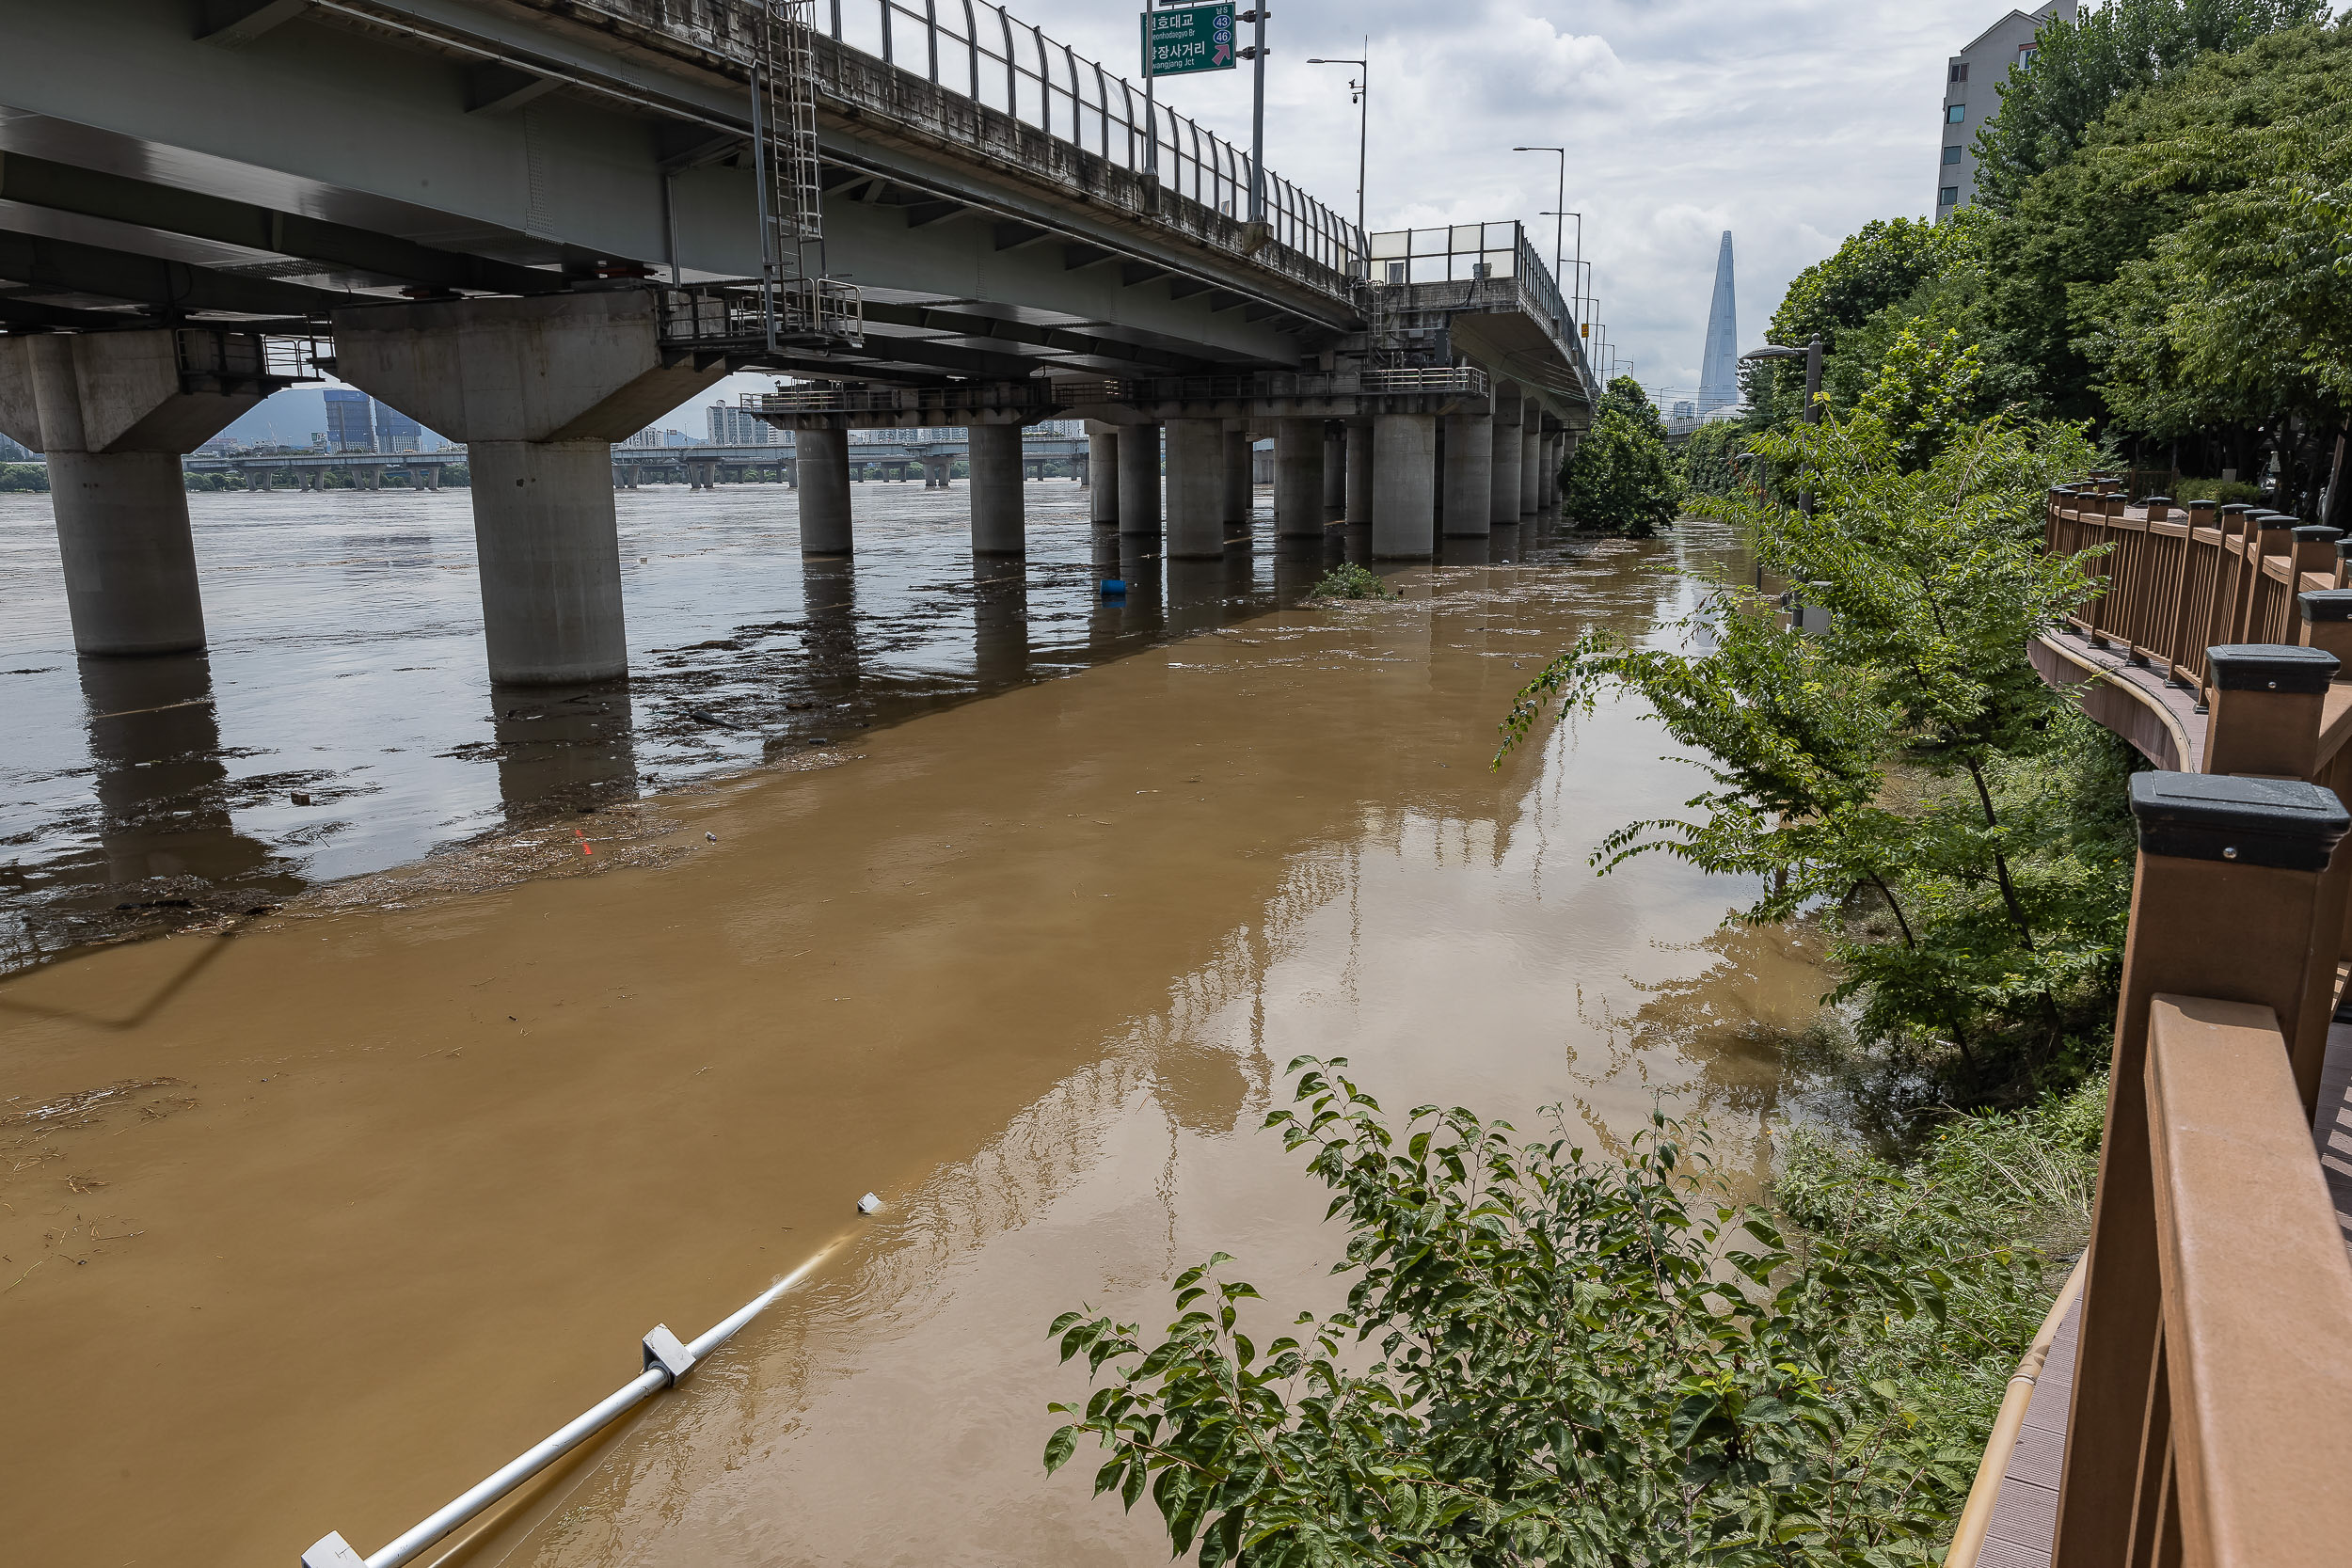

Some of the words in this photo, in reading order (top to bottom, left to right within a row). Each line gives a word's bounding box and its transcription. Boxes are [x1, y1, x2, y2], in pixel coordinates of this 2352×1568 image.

[1216, 17, 1228, 26] 43
[1152, 31, 1188, 40] eonhodaegyo
[1216, 32, 1228, 41] 46
[1152, 60, 1182, 70] wangjang
[1184, 57, 1195, 66] Jct
